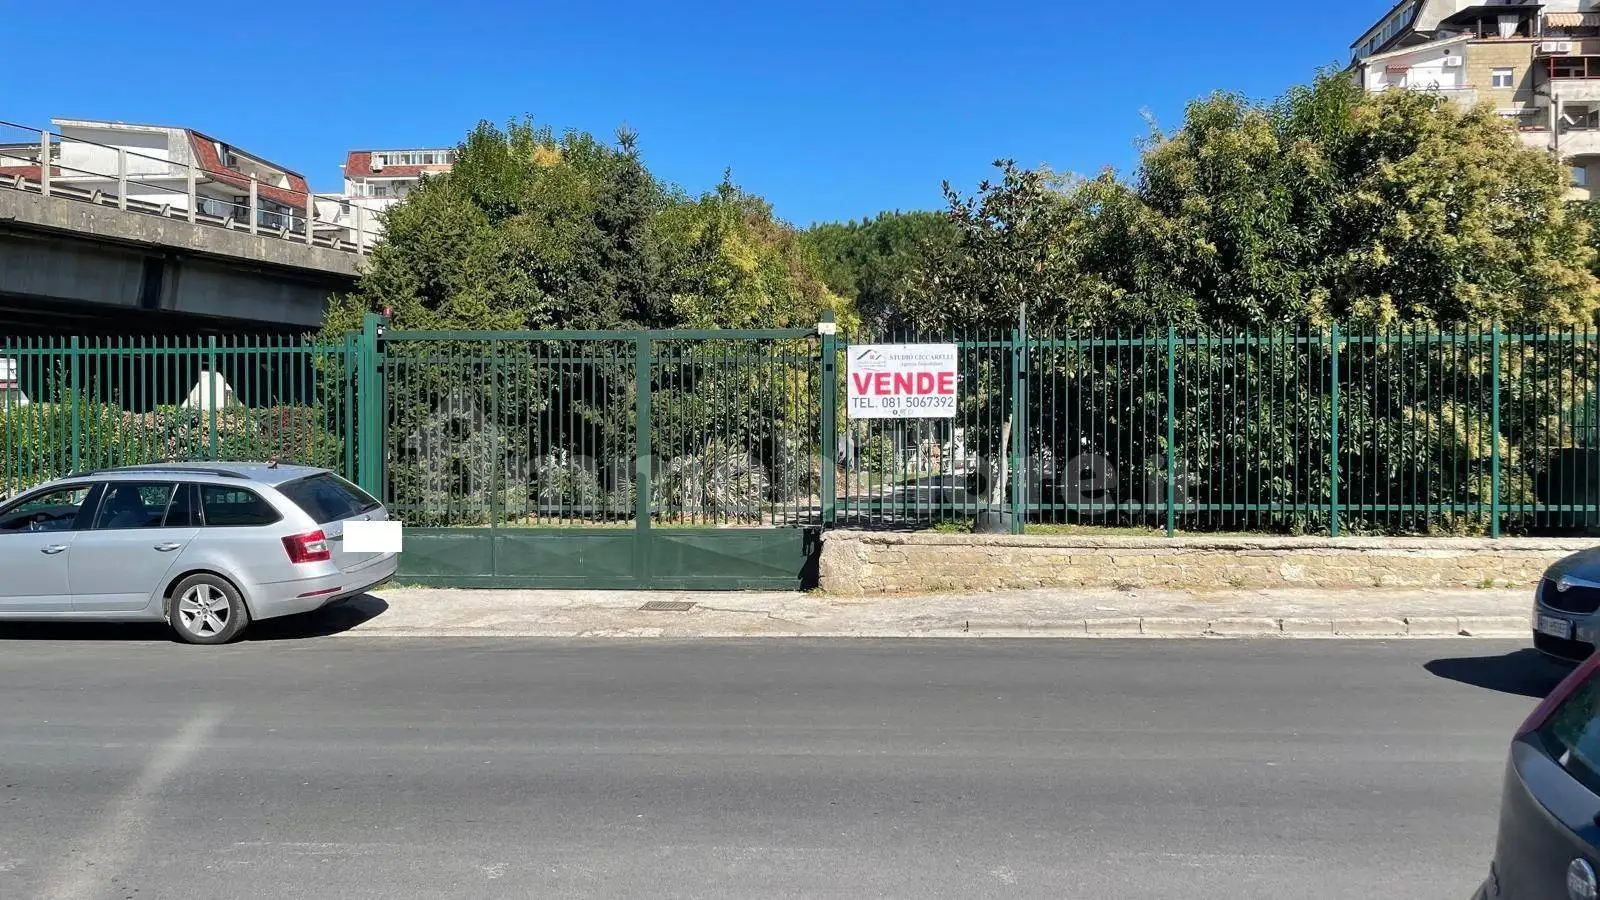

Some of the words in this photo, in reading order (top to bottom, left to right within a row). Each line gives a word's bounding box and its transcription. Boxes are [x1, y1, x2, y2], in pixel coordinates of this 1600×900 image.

[852, 371, 954, 395] VENDE
[852, 397, 878, 408] TEL.
[882, 397, 901, 408] 081
[906, 397, 954, 408] 5067392
